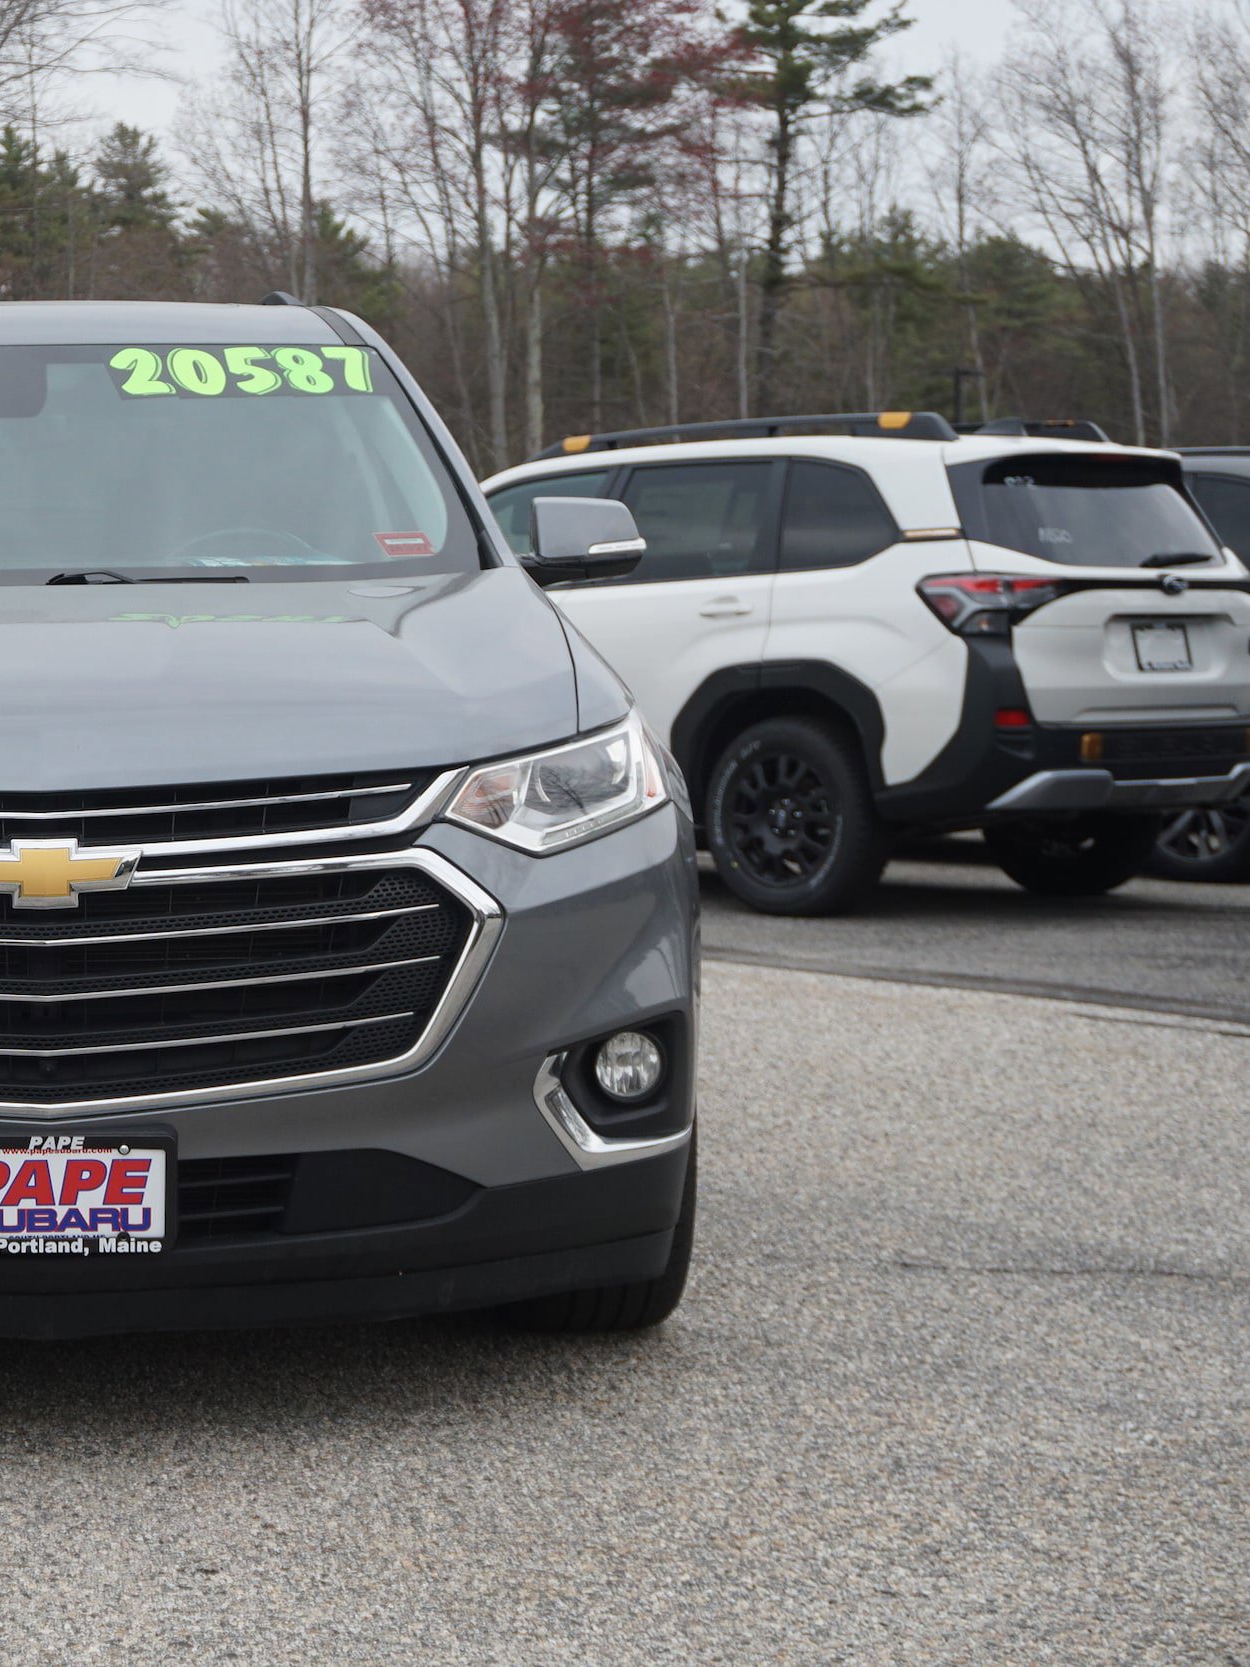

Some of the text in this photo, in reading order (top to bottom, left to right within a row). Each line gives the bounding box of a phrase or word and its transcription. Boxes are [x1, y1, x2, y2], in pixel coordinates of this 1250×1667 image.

[110, 346, 373, 395] 20587
[28, 1136, 85, 1151] PAPE
[99, 1238, 163, 1255] Maine
